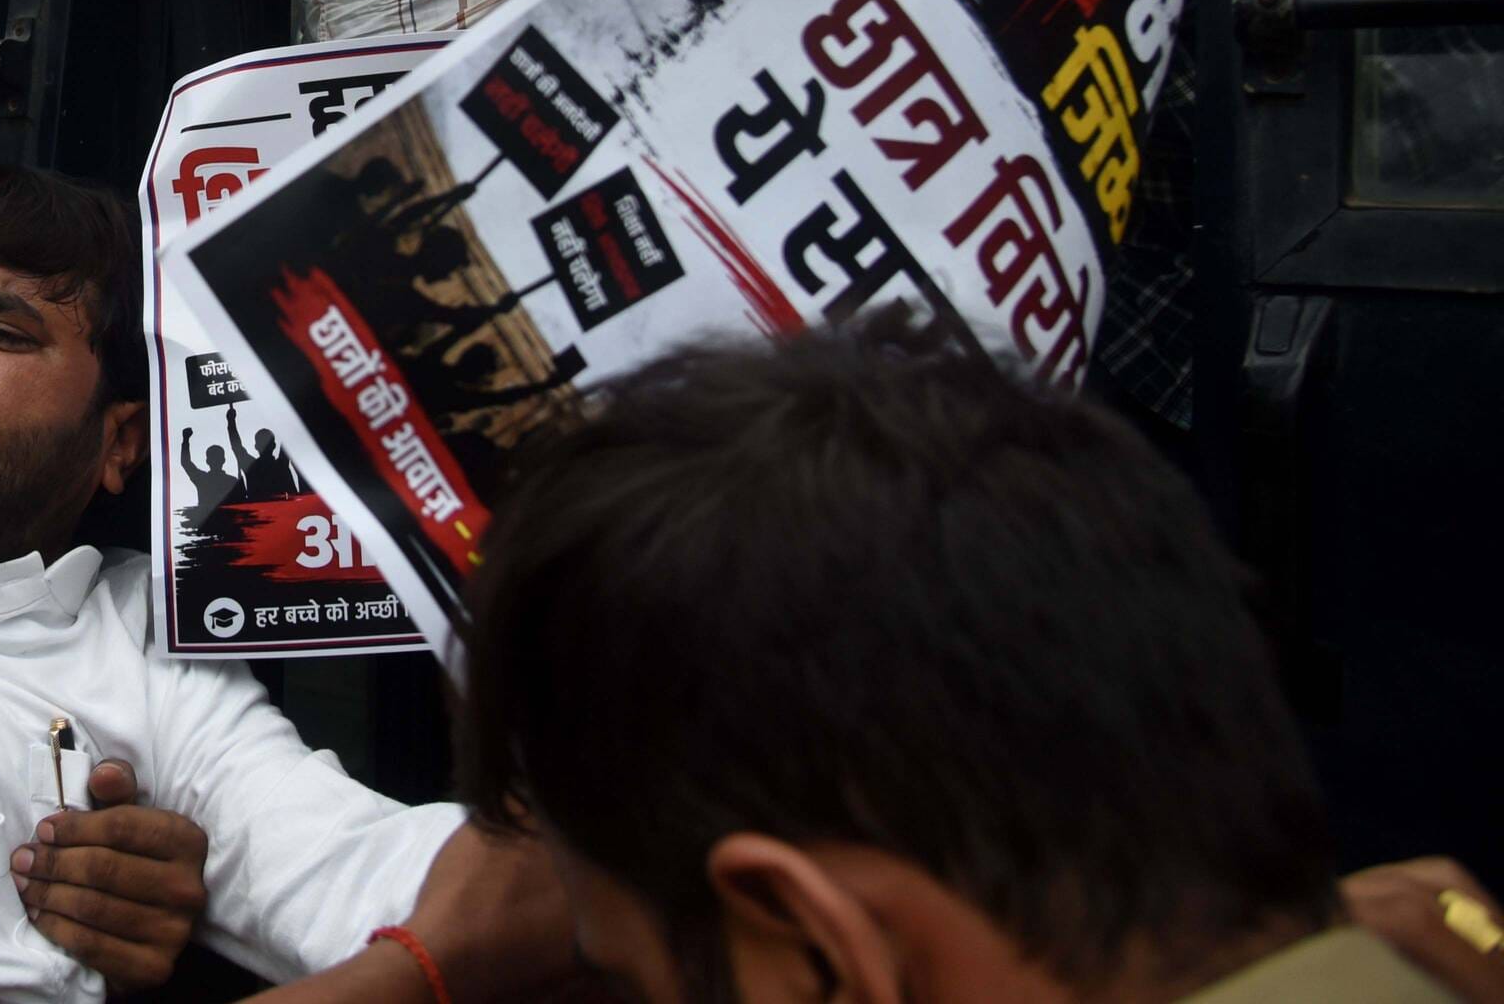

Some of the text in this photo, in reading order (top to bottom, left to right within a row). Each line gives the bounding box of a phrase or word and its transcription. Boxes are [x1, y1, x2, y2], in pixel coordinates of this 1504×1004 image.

[535, 73, 560, 97] की
[713, 67, 827, 206] ये
[942, 154, 1088, 381] विरो
[207, 380, 224, 396] बंद
[308, 304, 463, 523] छात्रों की आवाज़
[254, 606, 279, 628] हर
[283, 599, 320, 624] बच्चे
[324, 597, 349, 621] को
[355, 594, 399, 620] अच्छी
